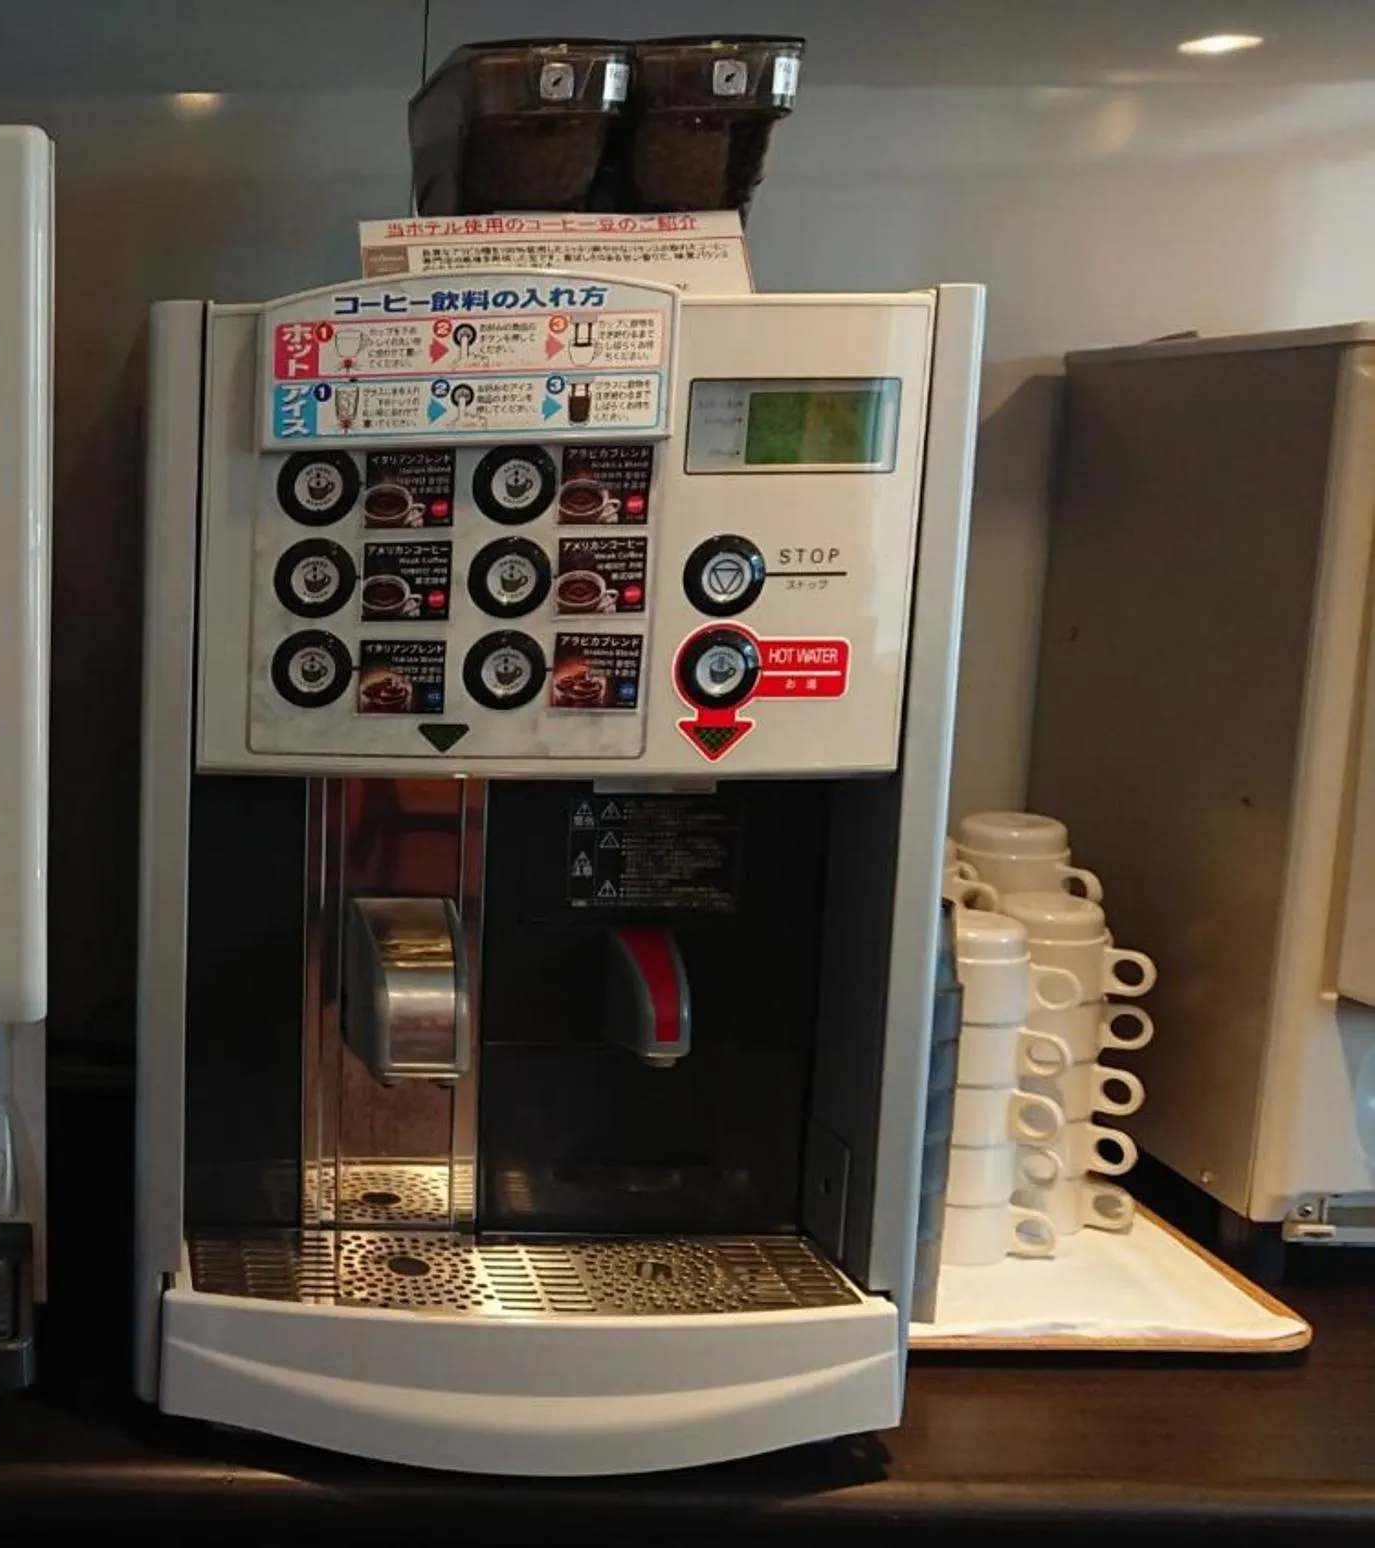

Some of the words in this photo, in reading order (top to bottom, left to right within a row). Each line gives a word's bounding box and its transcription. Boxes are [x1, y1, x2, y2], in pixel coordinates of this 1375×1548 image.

[387, 216, 698, 238] 当ホテル使用のコーヒー豆のご紹介
[334, 287, 608, 315] コーヒー飲料の入れ方
[282, 324, 313, 377] ホット
[281, 385, 310, 436] アイス
[568, 448, 649, 459] アラビカブレンド
[368, 546, 448, 556] アメリカンコーヒー
[564, 541, 644, 551] アメリカンコーヒー
[779, 548, 840, 563] STOP
[786, 579, 828, 589] ストップ
[560, 637, 640, 647] アラビカブレンド
[366, 644, 443, 654] イタリアンブレンド
[769, 649, 793, 663] HOT
[797, 649, 838, 663] WATER
